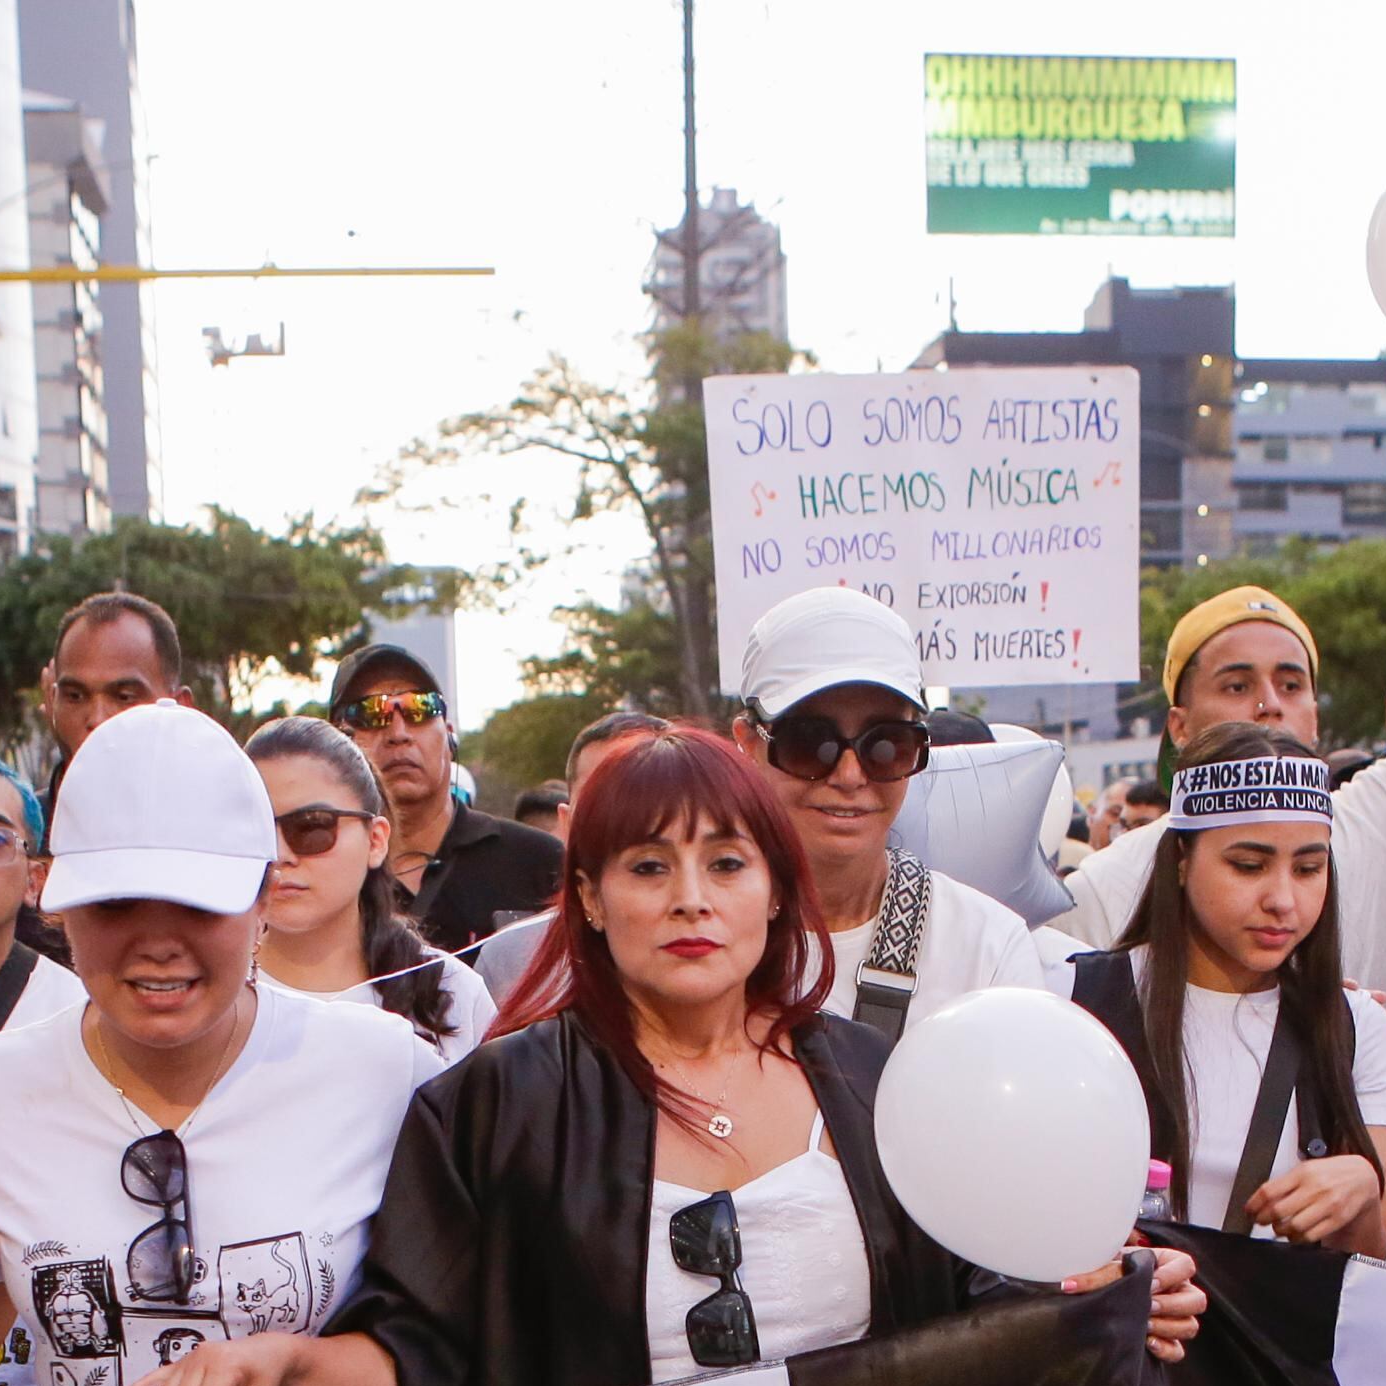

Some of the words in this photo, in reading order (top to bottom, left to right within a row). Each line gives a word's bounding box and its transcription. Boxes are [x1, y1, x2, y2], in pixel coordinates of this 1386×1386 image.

[732, 397, 833, 456] SOLO
[862, 395, 962, 444] SOMOS
[982, 397, 1119, 444] ARTISTAS
[798, 471, 946, 518] HACEMOS
[967, 458, 1079, 510] MÚSICA
[742, 538, 782, 578] NO
[805, 531, 897, 568] SOMOS
[931, 524, 1103, 562] MILLONARIOS
[1191, 792, 1278, 813] VIOLENCIA
[1283, 792, 1328, 814] NUNCA
